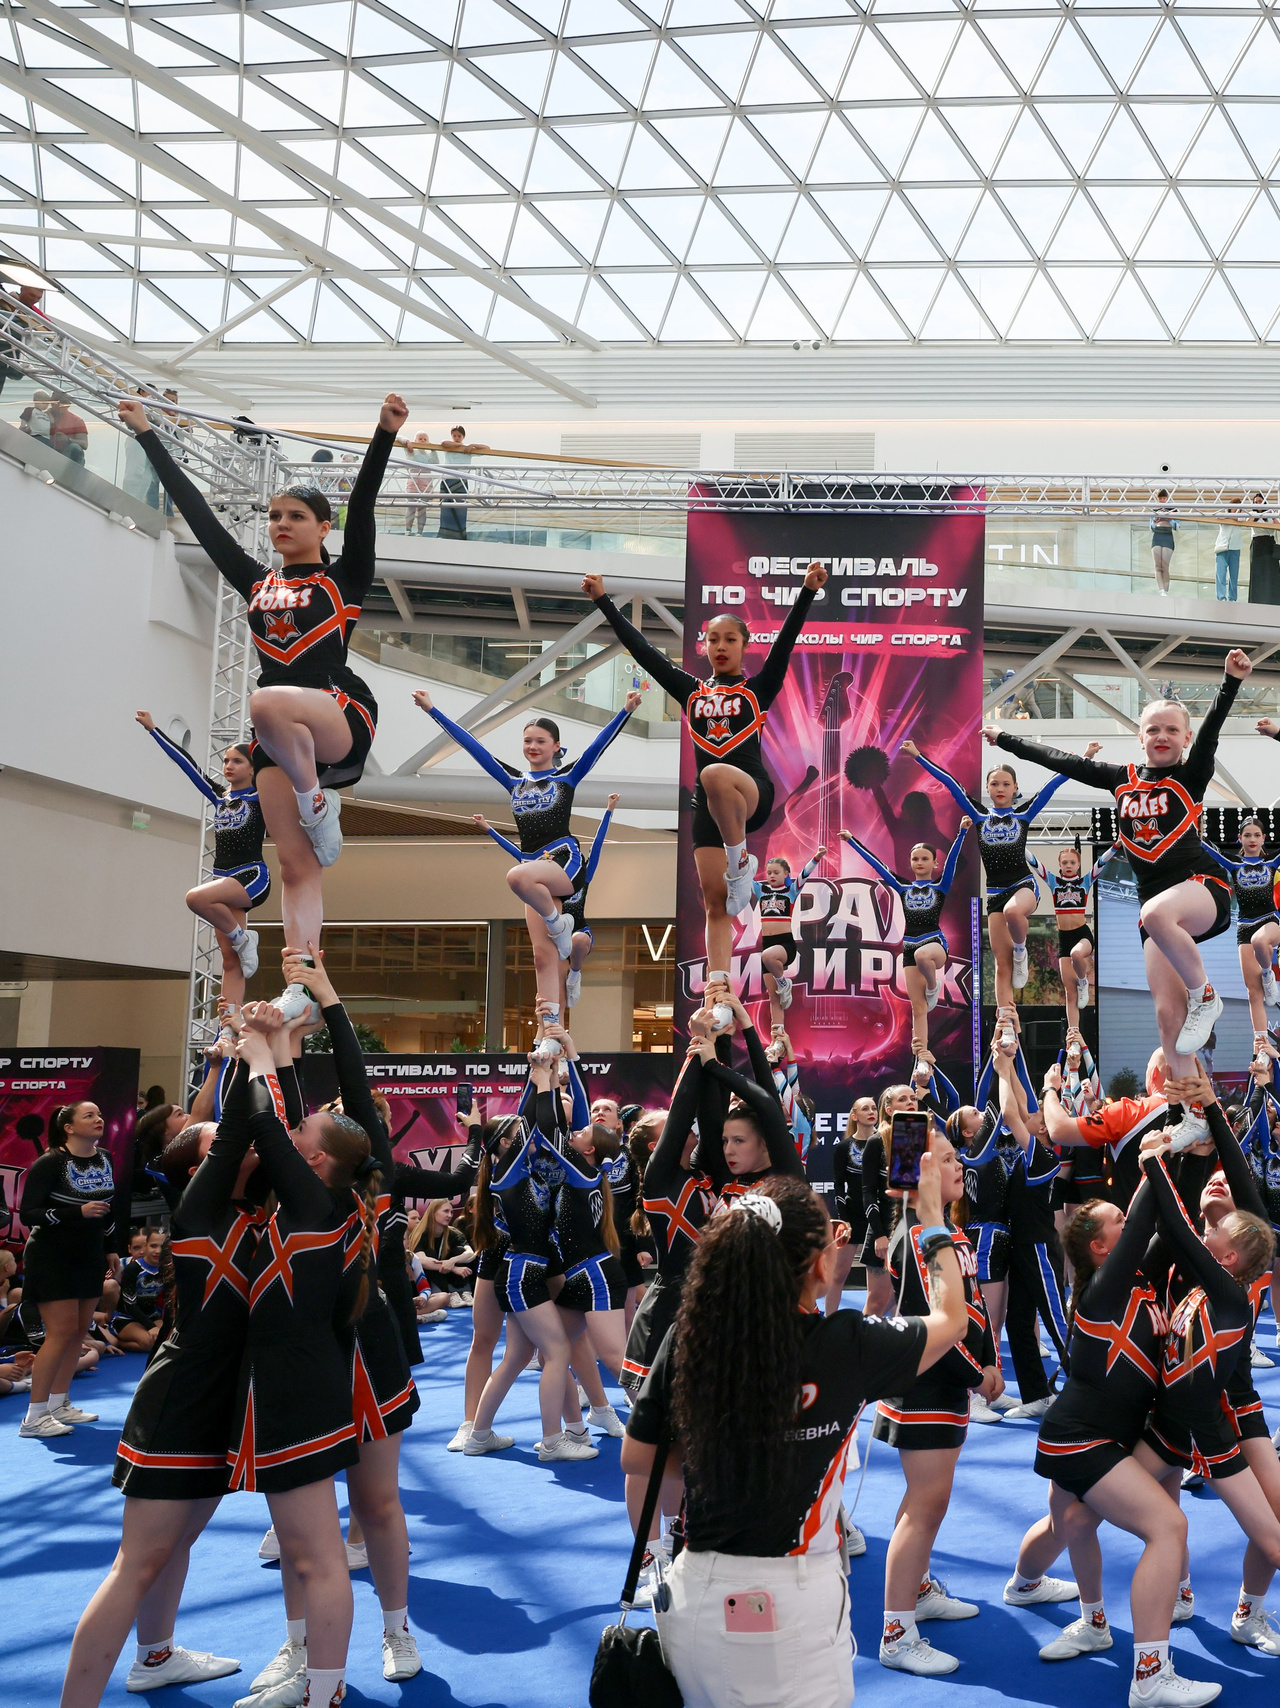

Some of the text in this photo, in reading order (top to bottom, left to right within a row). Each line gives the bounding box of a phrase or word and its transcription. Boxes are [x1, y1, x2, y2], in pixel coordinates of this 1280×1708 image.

[248, 587, 313, 613] FOXES
[701, 585, 746, 605] ПО
[841, 587, 967, 608] СПОРТУ
[795, 633, 843, 645] КОЛЫ
[850, 633, 884, 646] ЧИР
[891, 633, 963, 646] СПОРТА
[694, 694, 742, 719] FOXES
[1120, 791, 1170, 819] FOXES
[812, 948, 849, 991] И
[859, 949, 973, 1006] РК
[20, 1057, 94, 1069] СПОРТУ
[365, 1063, 458, 1077] ЕСТИВАЛЬ
[465, 1063, 490, 1076] ПО
[11, 1080, 67, 1090] СПОРТА
[377, 1086, 448, 1095] УРАЛЬСКАЯ
[453, 1085, 493, 1095] ШОЛА
